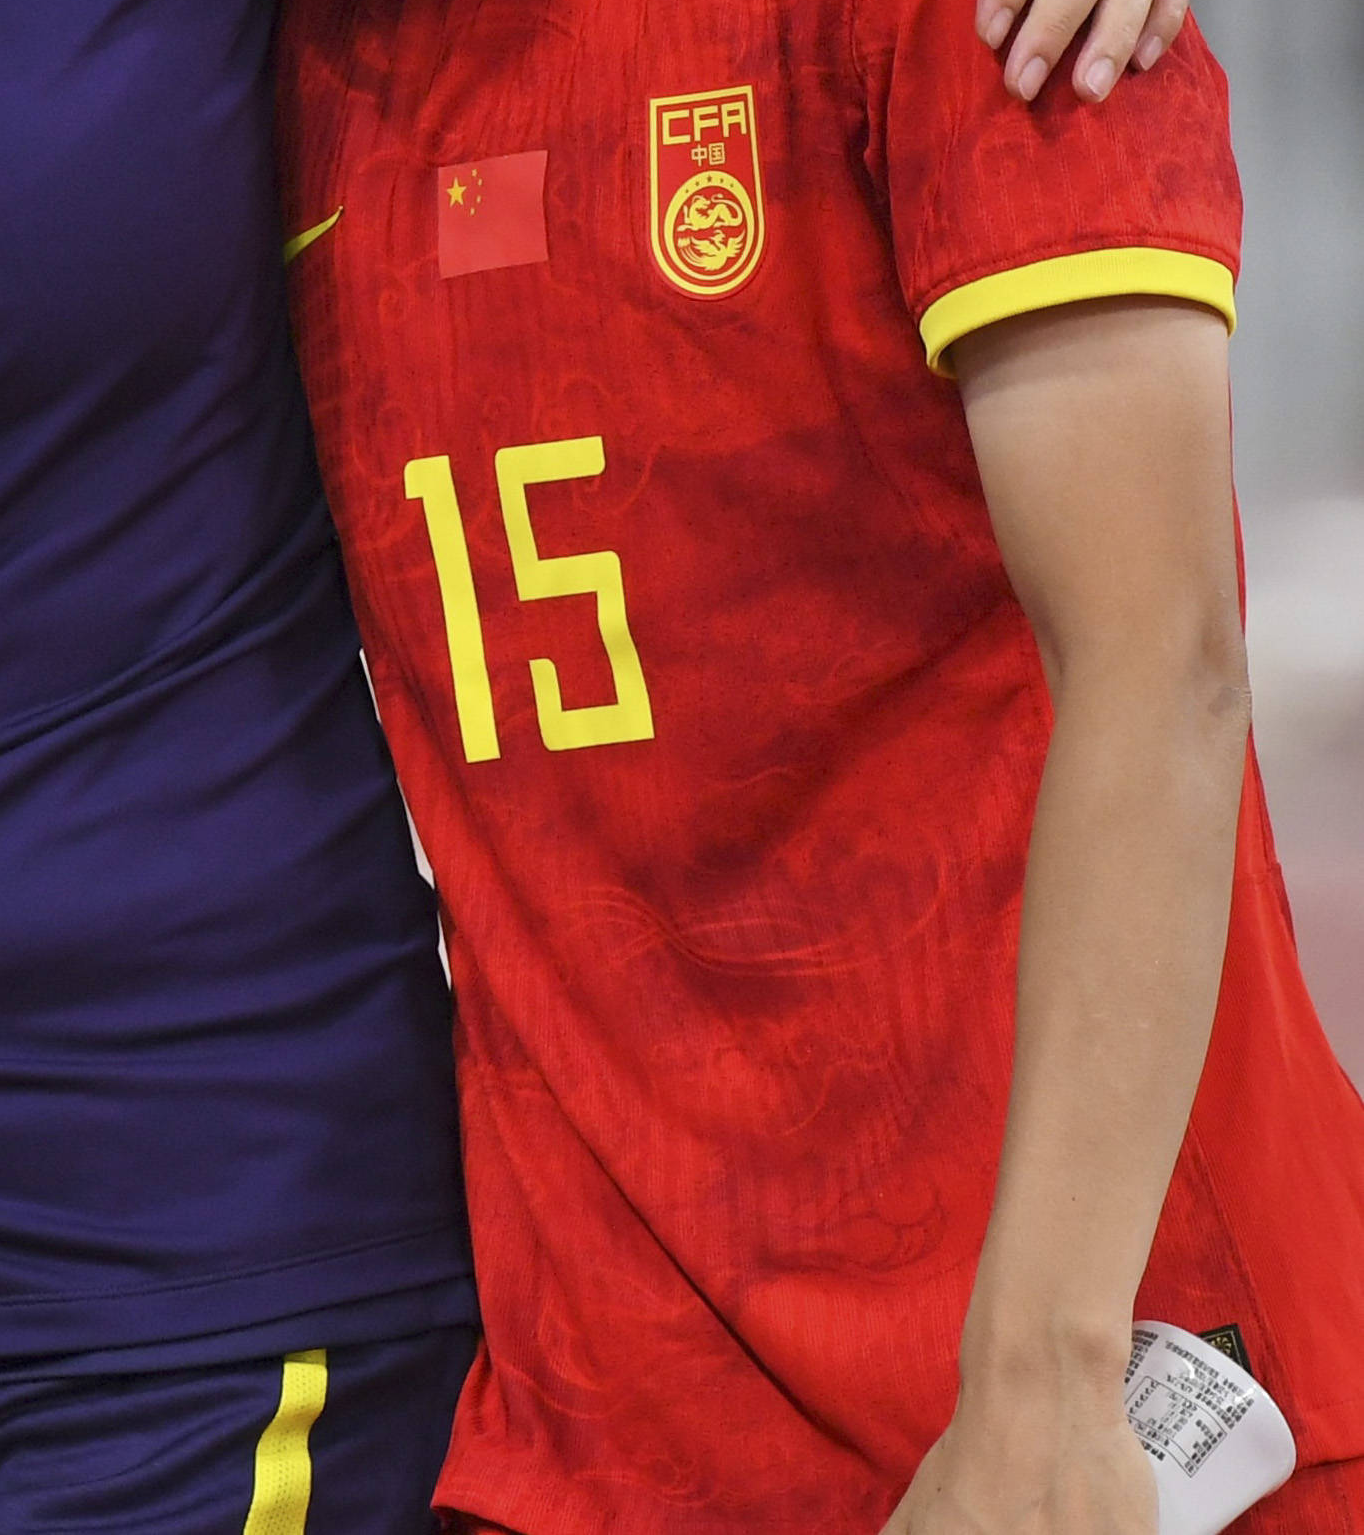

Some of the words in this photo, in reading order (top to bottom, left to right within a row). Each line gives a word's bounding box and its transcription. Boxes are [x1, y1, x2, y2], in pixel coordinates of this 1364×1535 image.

[662, 100, 747, 146] CFA
[690, 142, 726, 167] 中国
[403, 435, 655, 763] 15
